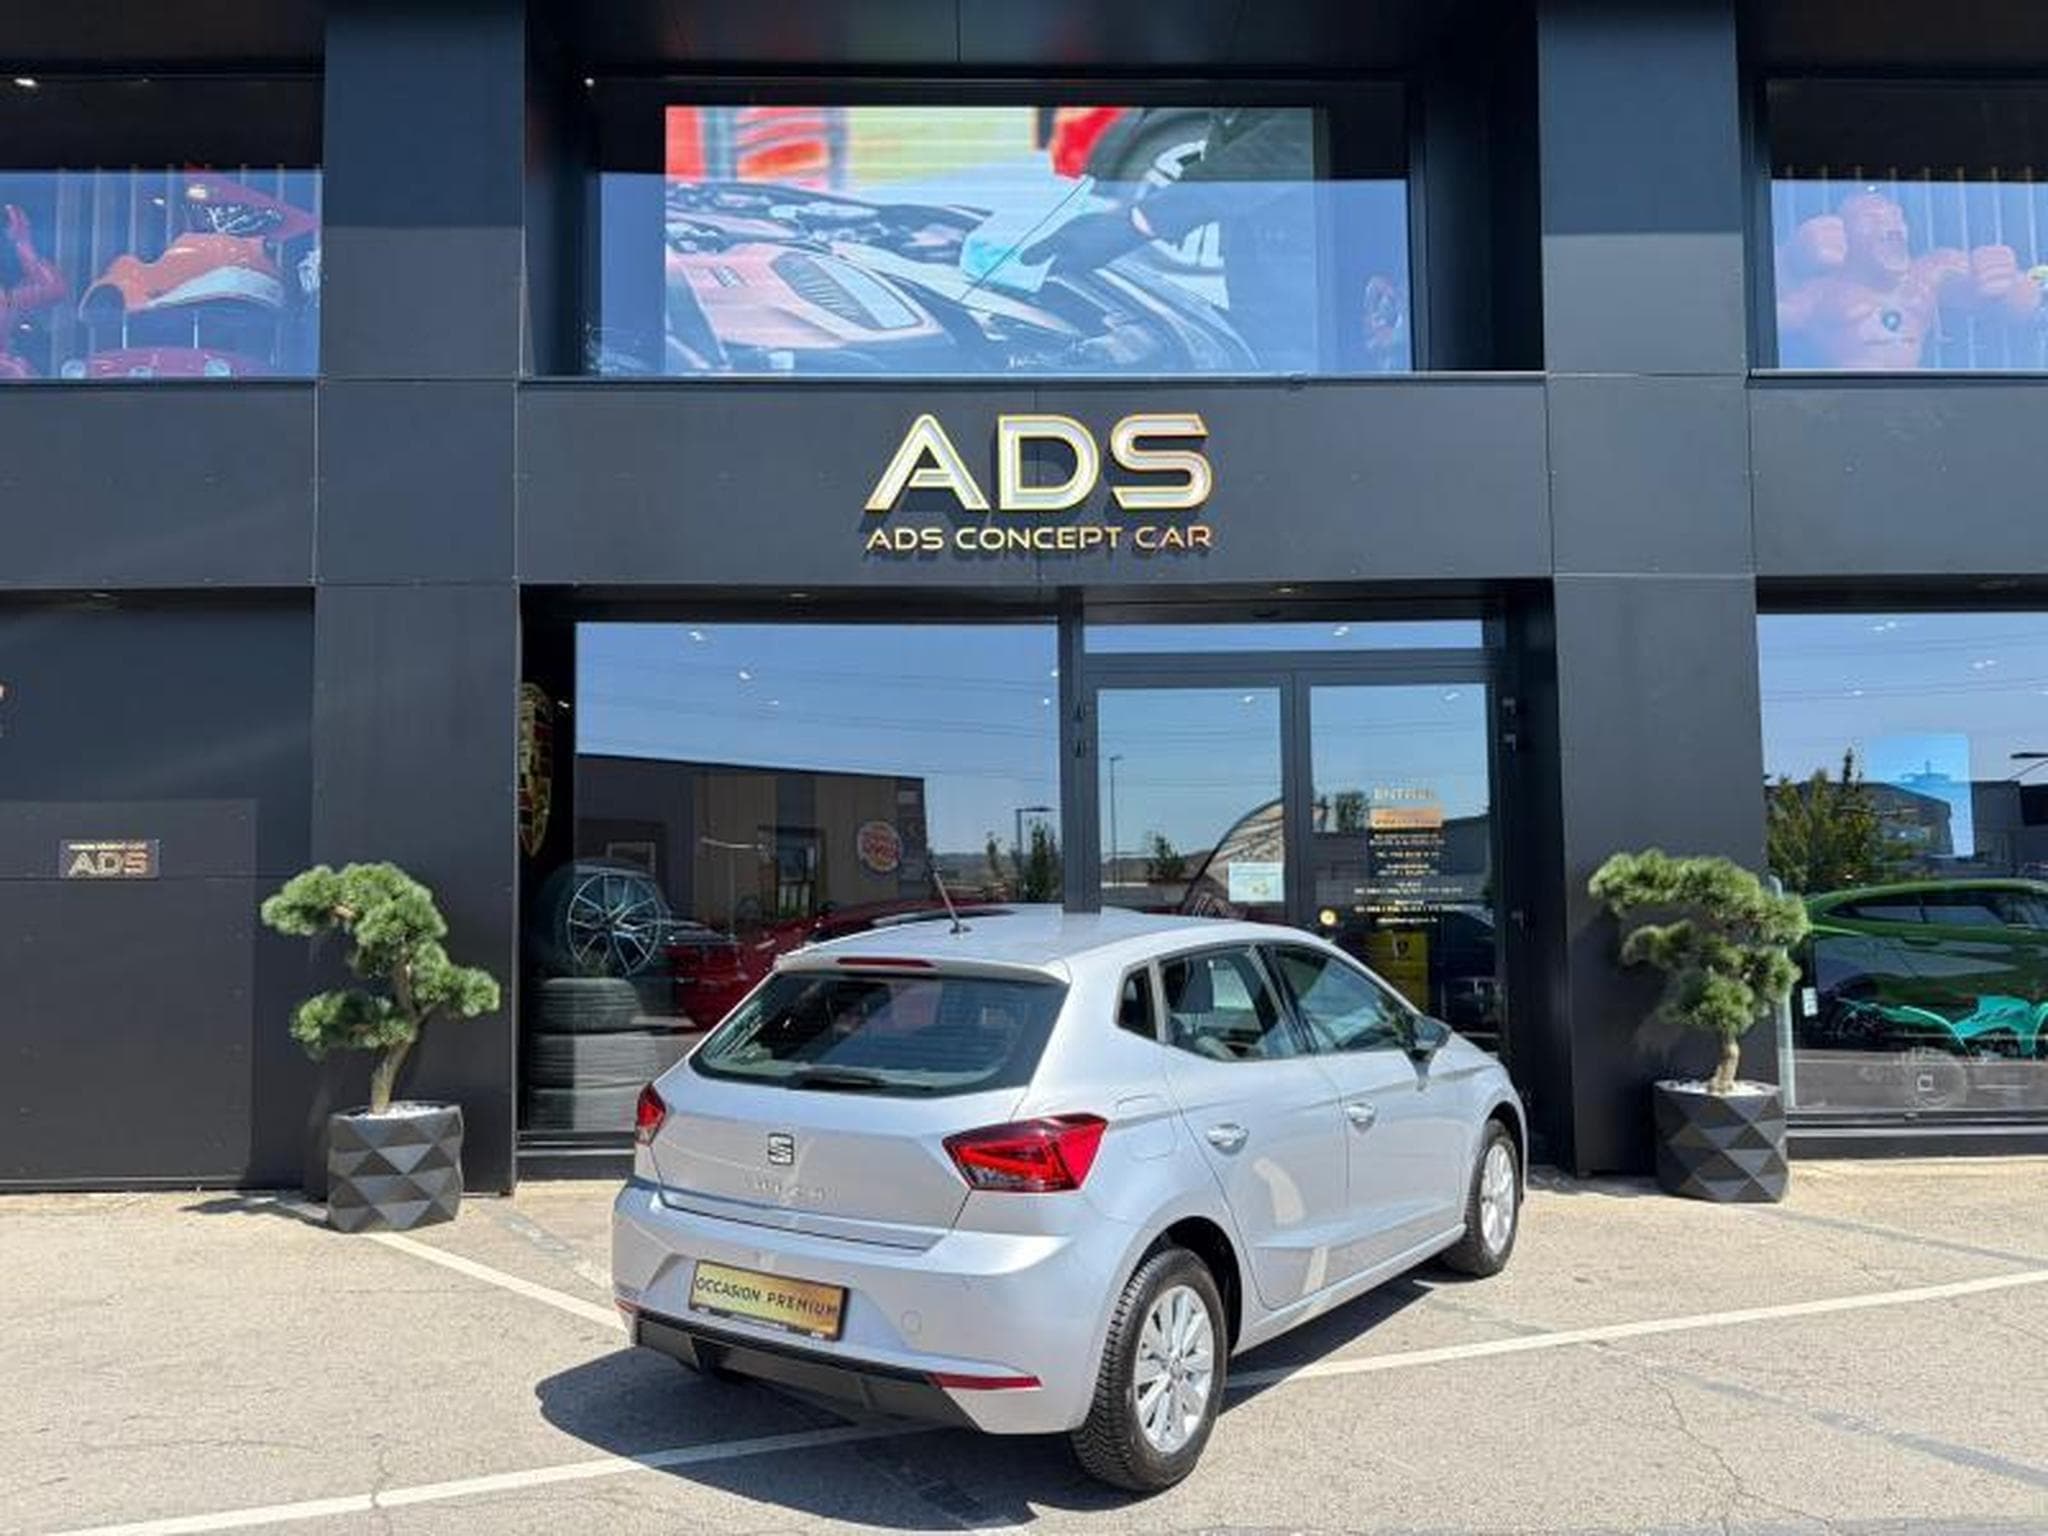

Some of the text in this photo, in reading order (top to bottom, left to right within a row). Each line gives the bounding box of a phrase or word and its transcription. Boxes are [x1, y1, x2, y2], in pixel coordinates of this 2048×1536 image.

[864, 413, 1212, 510] ADS
[865, 525, 1212, 550] ADS CONCEPT CAR
[68, 851, 148, 876] ADS
[695, 1276, 838, 1315] OCCASION PREMIUM
